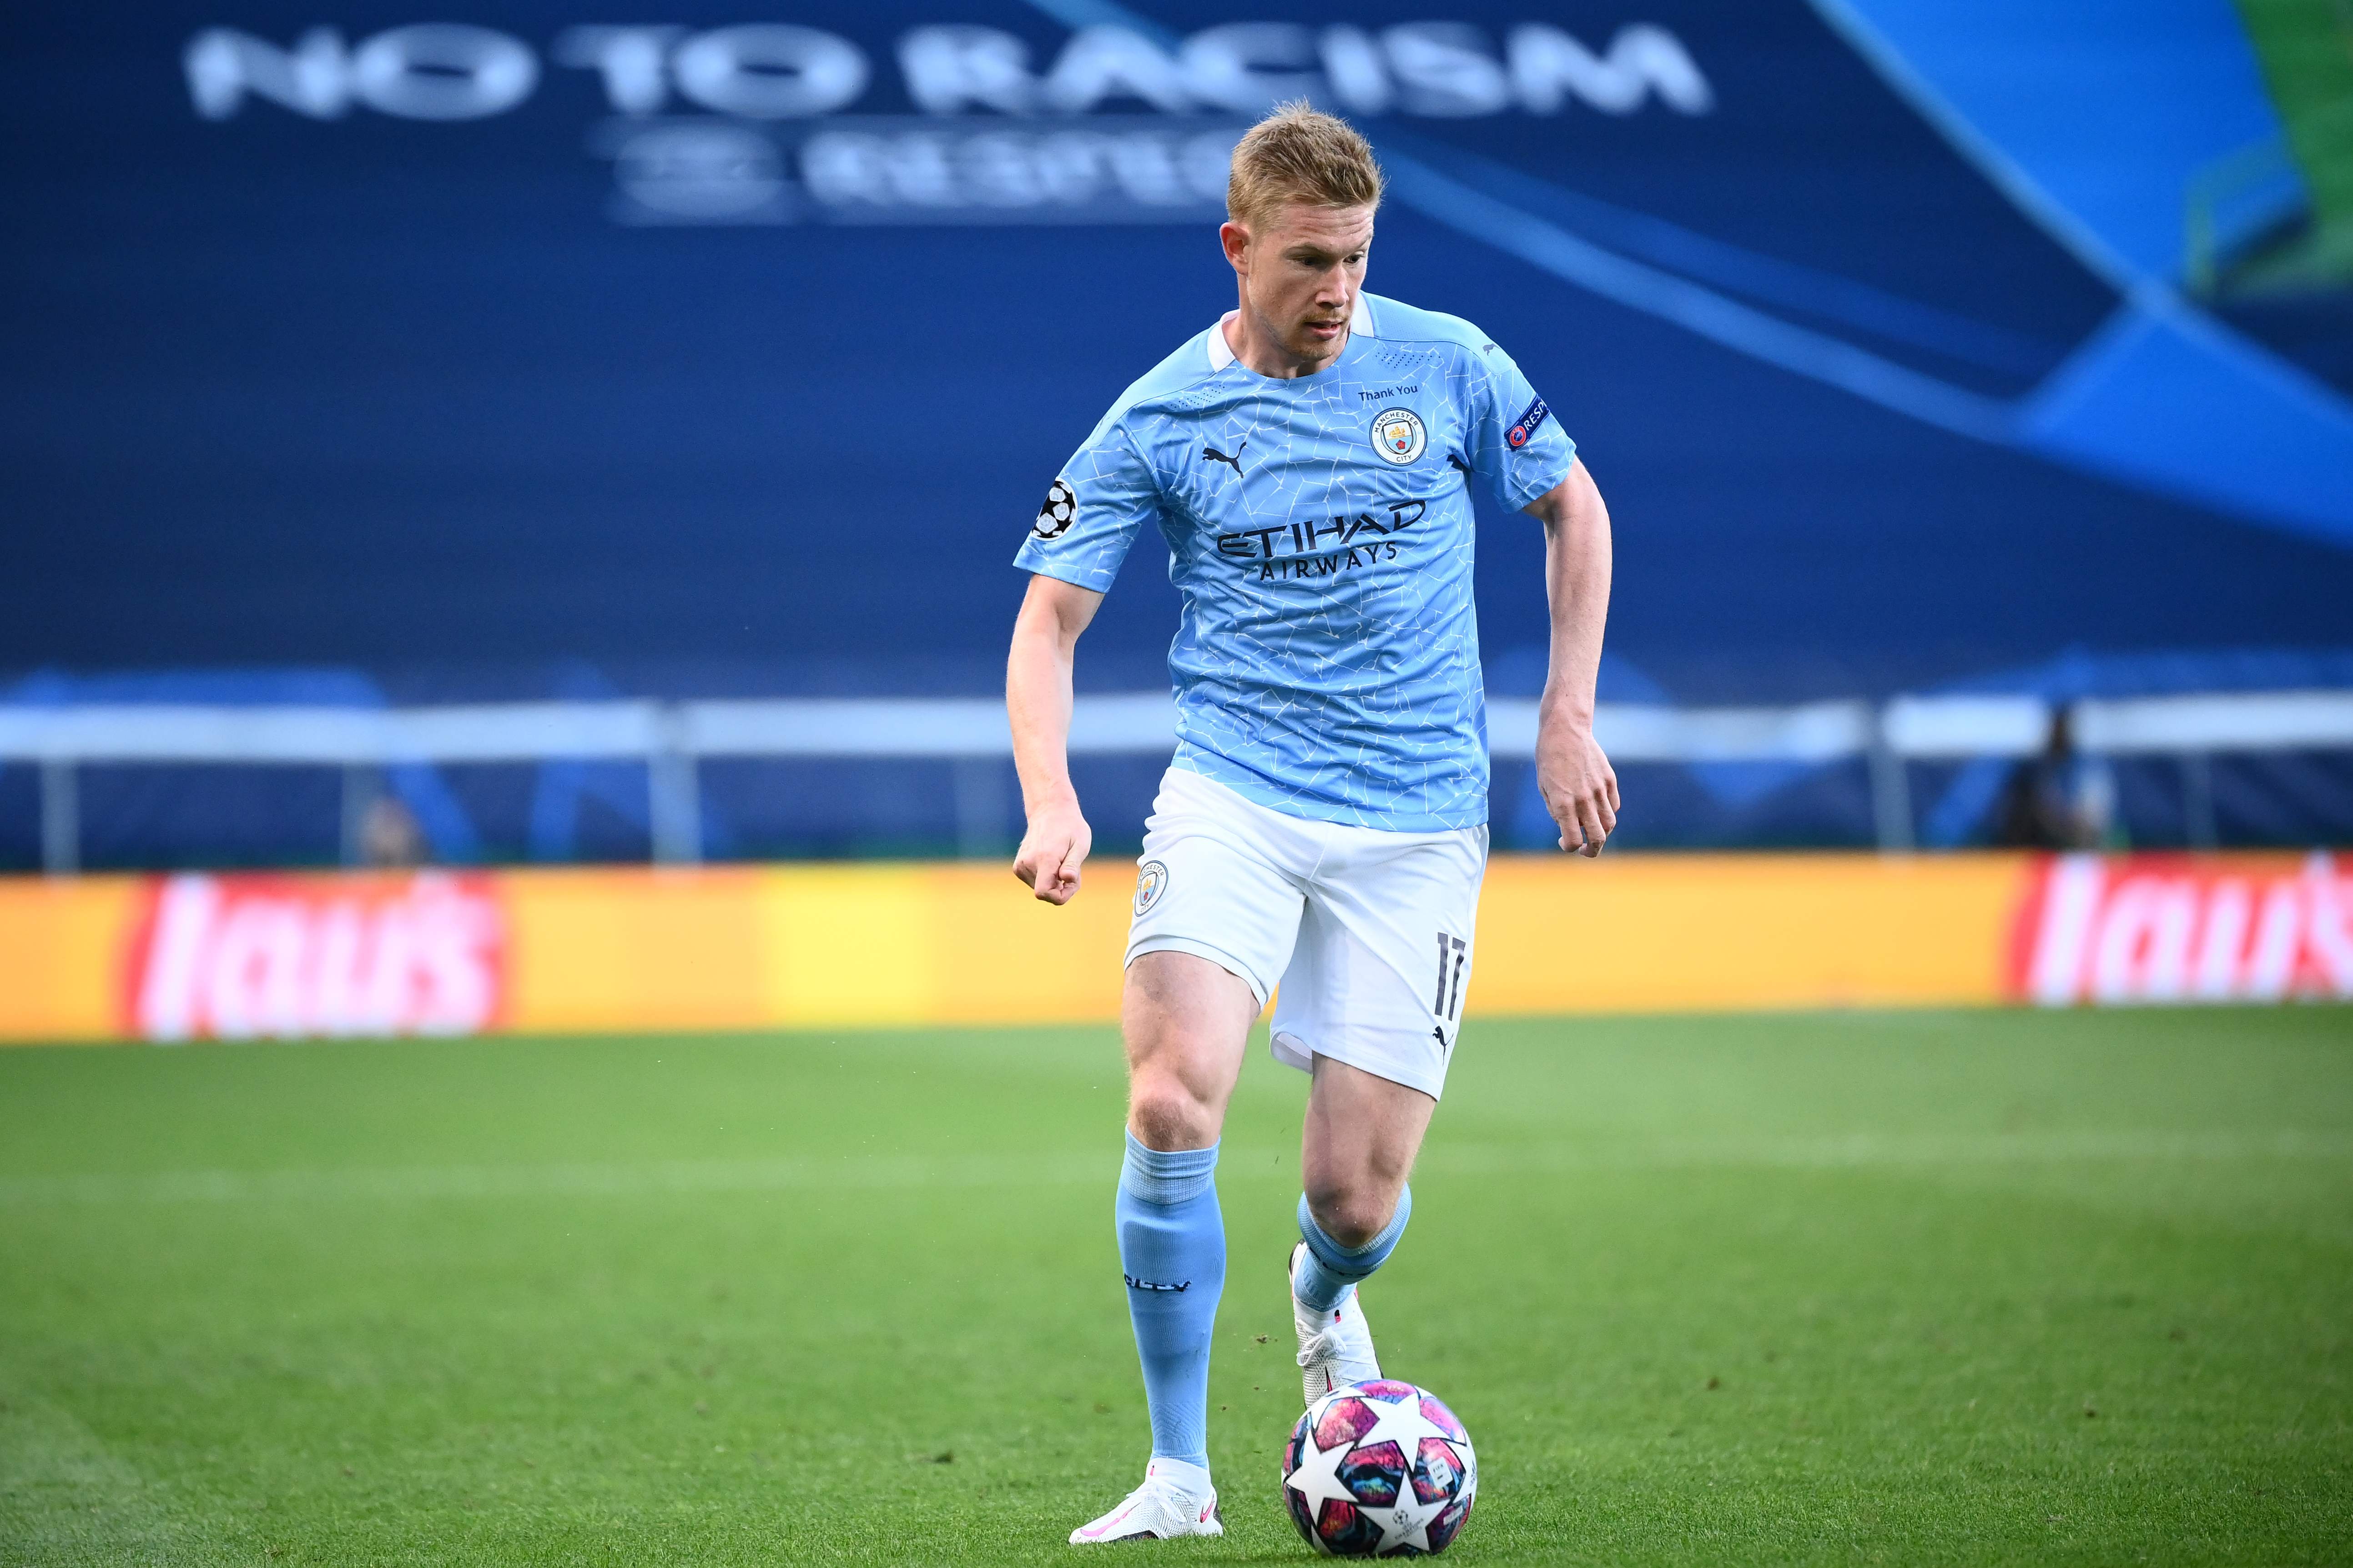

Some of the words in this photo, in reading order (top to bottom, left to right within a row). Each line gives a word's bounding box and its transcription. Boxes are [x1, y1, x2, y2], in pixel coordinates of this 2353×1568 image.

[184, 24, 539, 120] NO
[555, 24, 867, 118] TO
[896, 22, 1713, 117] RACISM
[1358, 388, 1394, 401] Thank
[1396, 386, 1418, 395] You
[1375, 412, 1418, 433] MANCHESTER
[1217, 500, 1426, 558] ETIHAD
[1260, 542, 1397, 580] AIRWAYS
[1435, 932, 1466, 1021] 17
